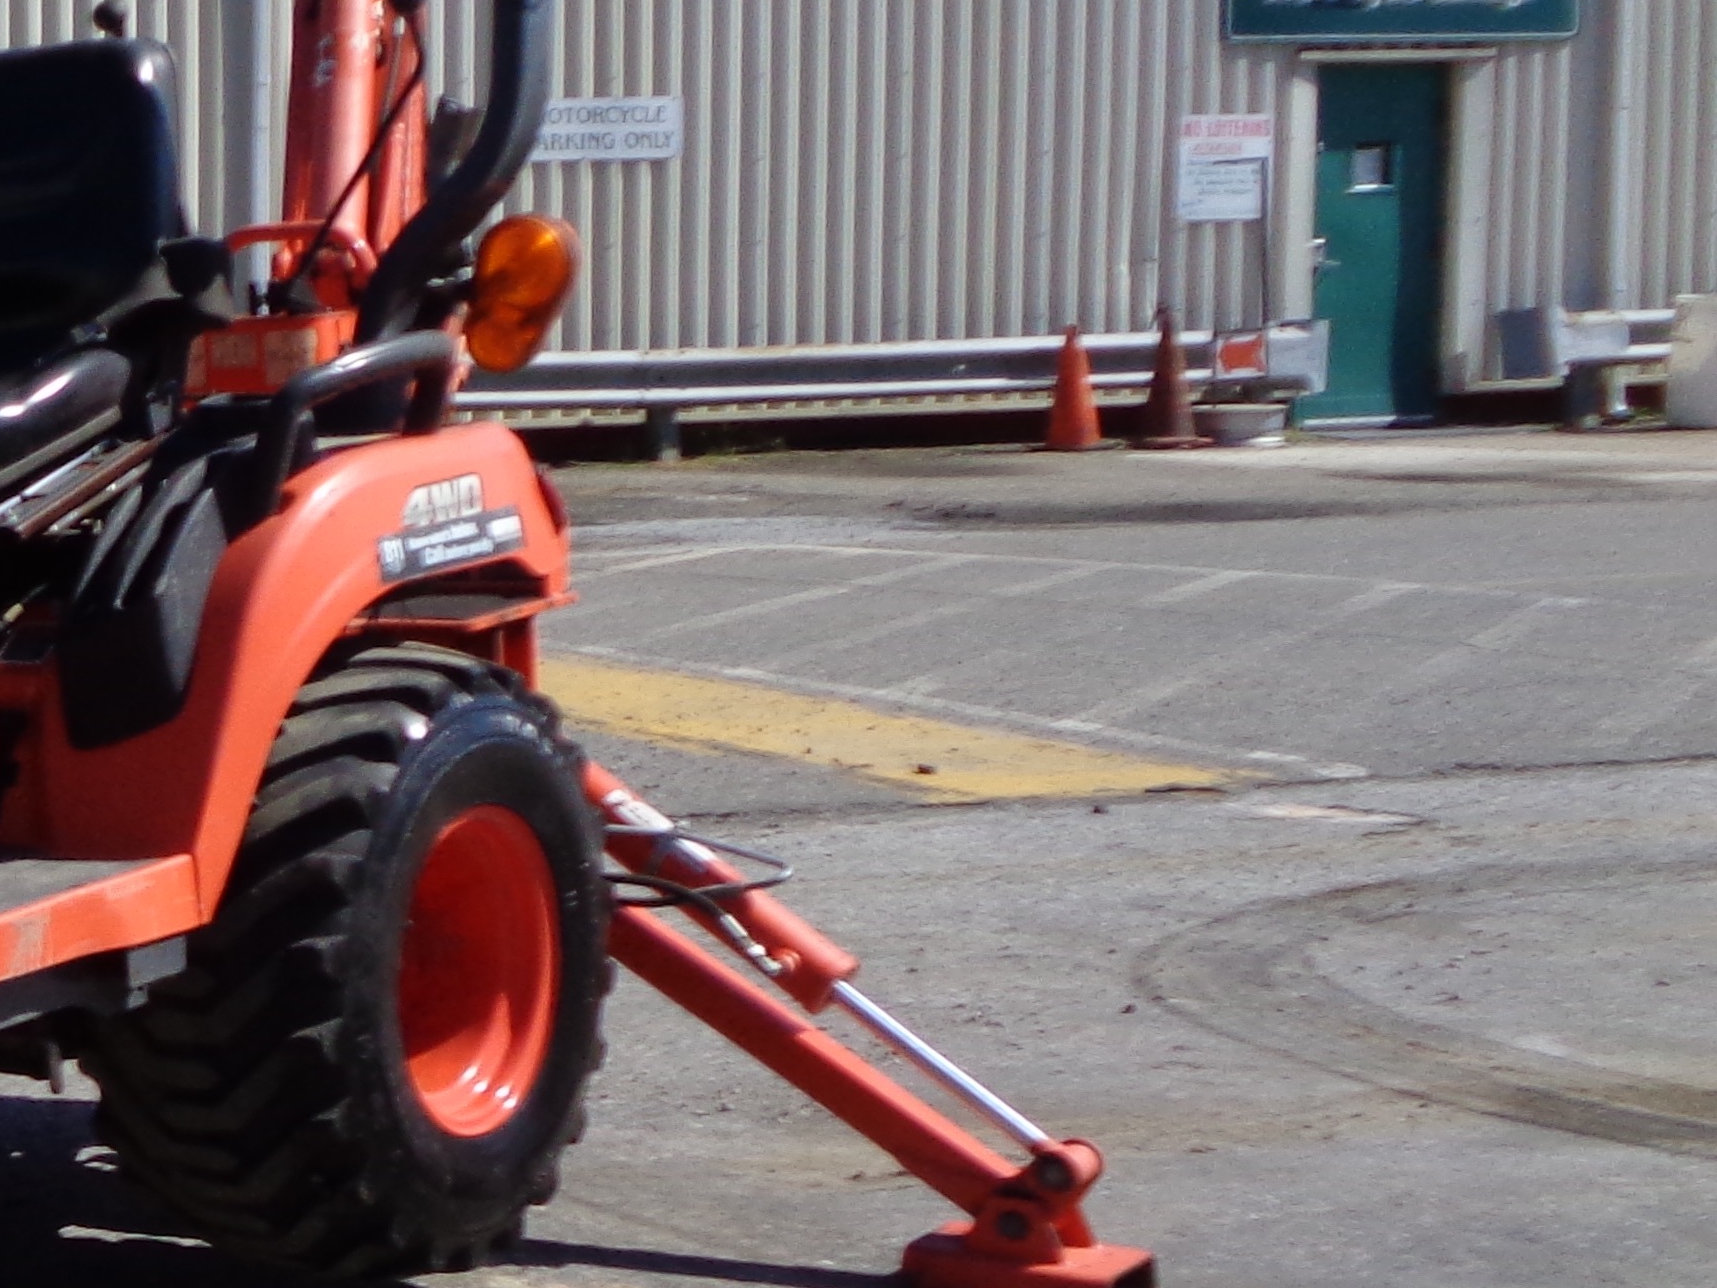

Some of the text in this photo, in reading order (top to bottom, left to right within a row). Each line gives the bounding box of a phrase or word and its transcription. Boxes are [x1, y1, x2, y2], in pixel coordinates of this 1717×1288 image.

[543, 105, 667, 125] OTORCYCLE
[538, 131, 674, 151] ARKING ONLY
[403, 474, 484, 527] 4WD
